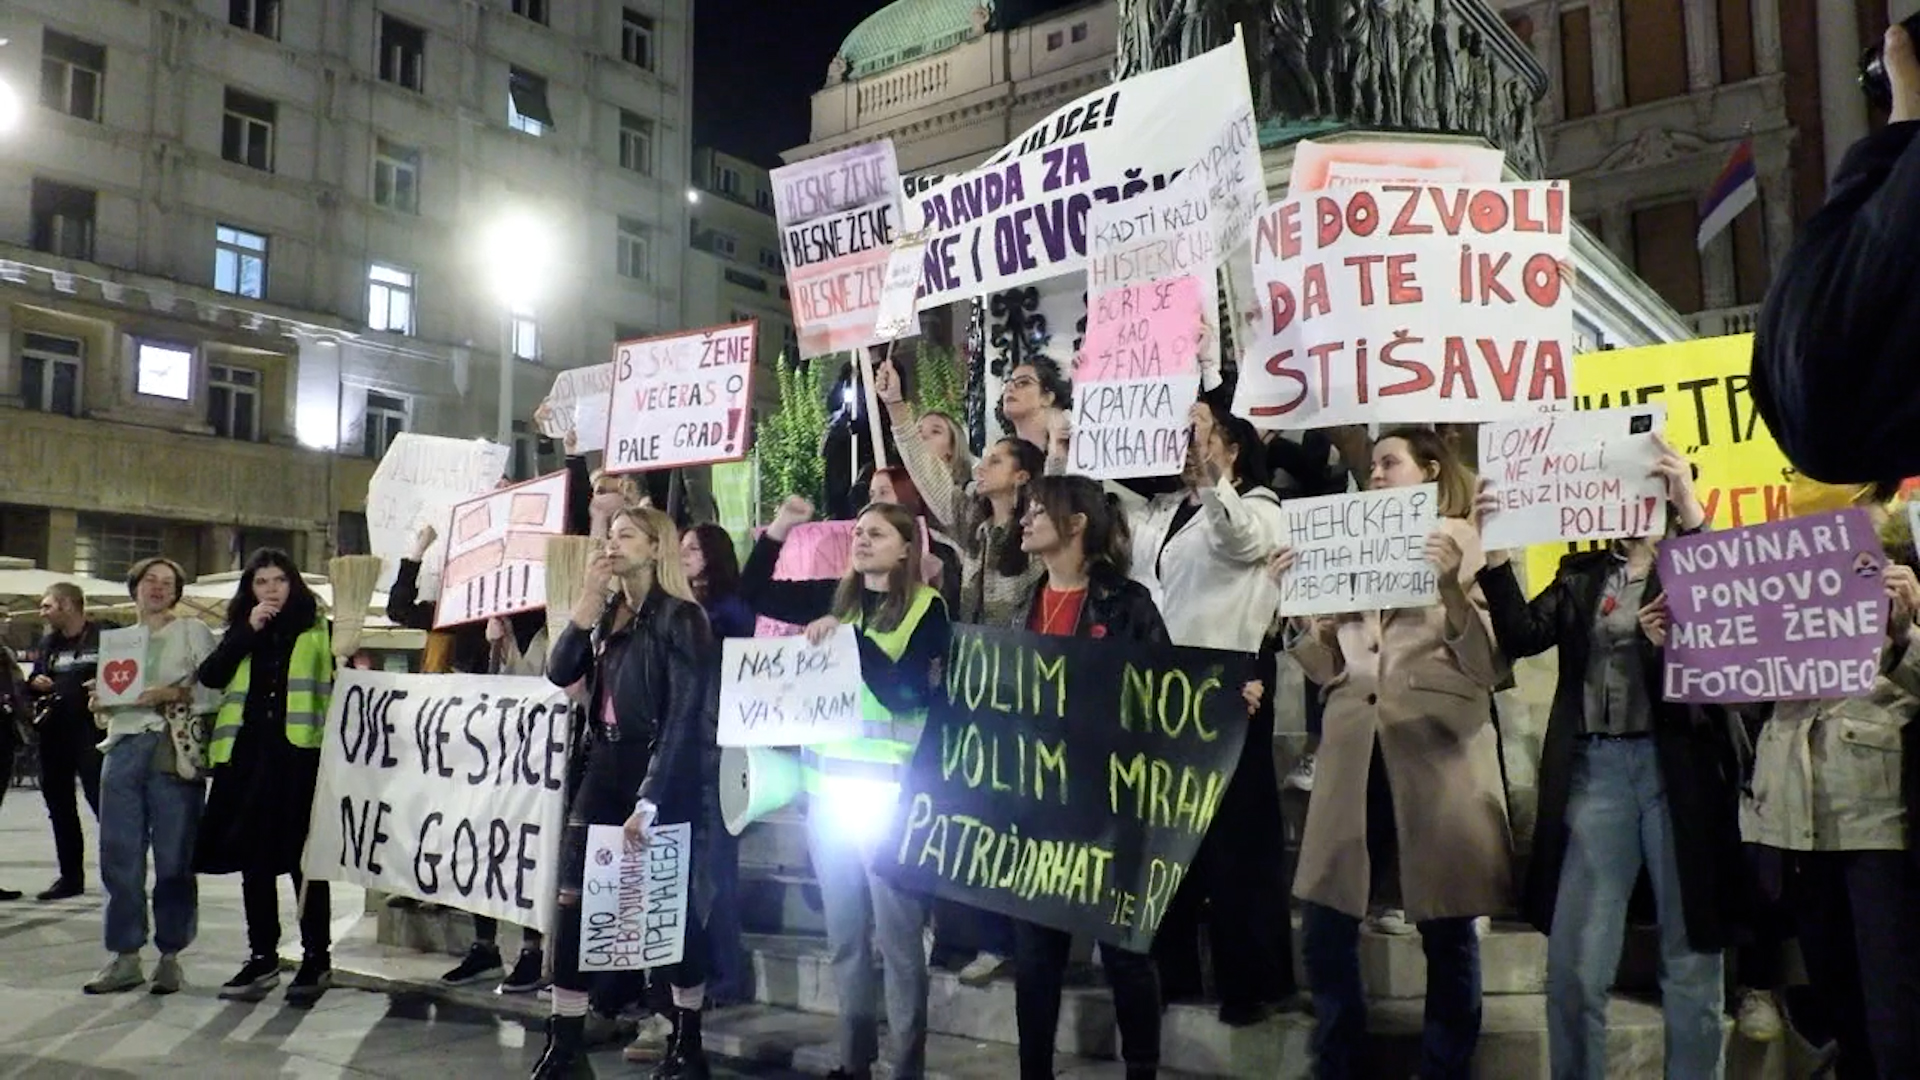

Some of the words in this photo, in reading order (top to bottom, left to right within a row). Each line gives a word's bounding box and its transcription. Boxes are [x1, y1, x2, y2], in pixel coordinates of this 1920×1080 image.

[921, 162, 1024, 232] PRAVDA
[1042, 142, 1091, 193] ZA
[789, 218, 847, 268] BESNE
[847, 204, 894, 255] ŽENE
[1255, 201, 1302, 264] NE
[1267, 263, 1331, 336] DA
[1344, 253, 1423, 307] TE
[1459, 243, 1562, 309] IKO
[698, 331, 751, 369] ŽENE
[1249, 329, 1568, 417] STIŠAVA
[632, 380, 718, 413] VEČERAS
[617, 434, 661, 464] PALE
[673, 408, 744, 453] GRAD!
[1486, 415, 1556, 464] LOMI
[1504, 457, 1533, 483] NE
[1541, 441, 1608, 477] MOLI
[1288, 498, 1404, 548] ЖЕНСКА
[1359, 534, 1425, 566] НИЈЕ
[1670, 514, 1850, 576] NOVINARI
[1690, 567, 1842, 612] PONOVO
[1671, 614, 1759, 650] MRZE
[1781, 600, 1879, 642] ŽENE
[946, 633, 1067, 718] VOLIM
[340, 684, 409, 769] OVE
[414, 693, 568, 790] VEŠTICE
[941, 722, 1068, 806] VOLIM
[340, 795, 392, 876] NE
[413, 811, 541, 910] GORE
